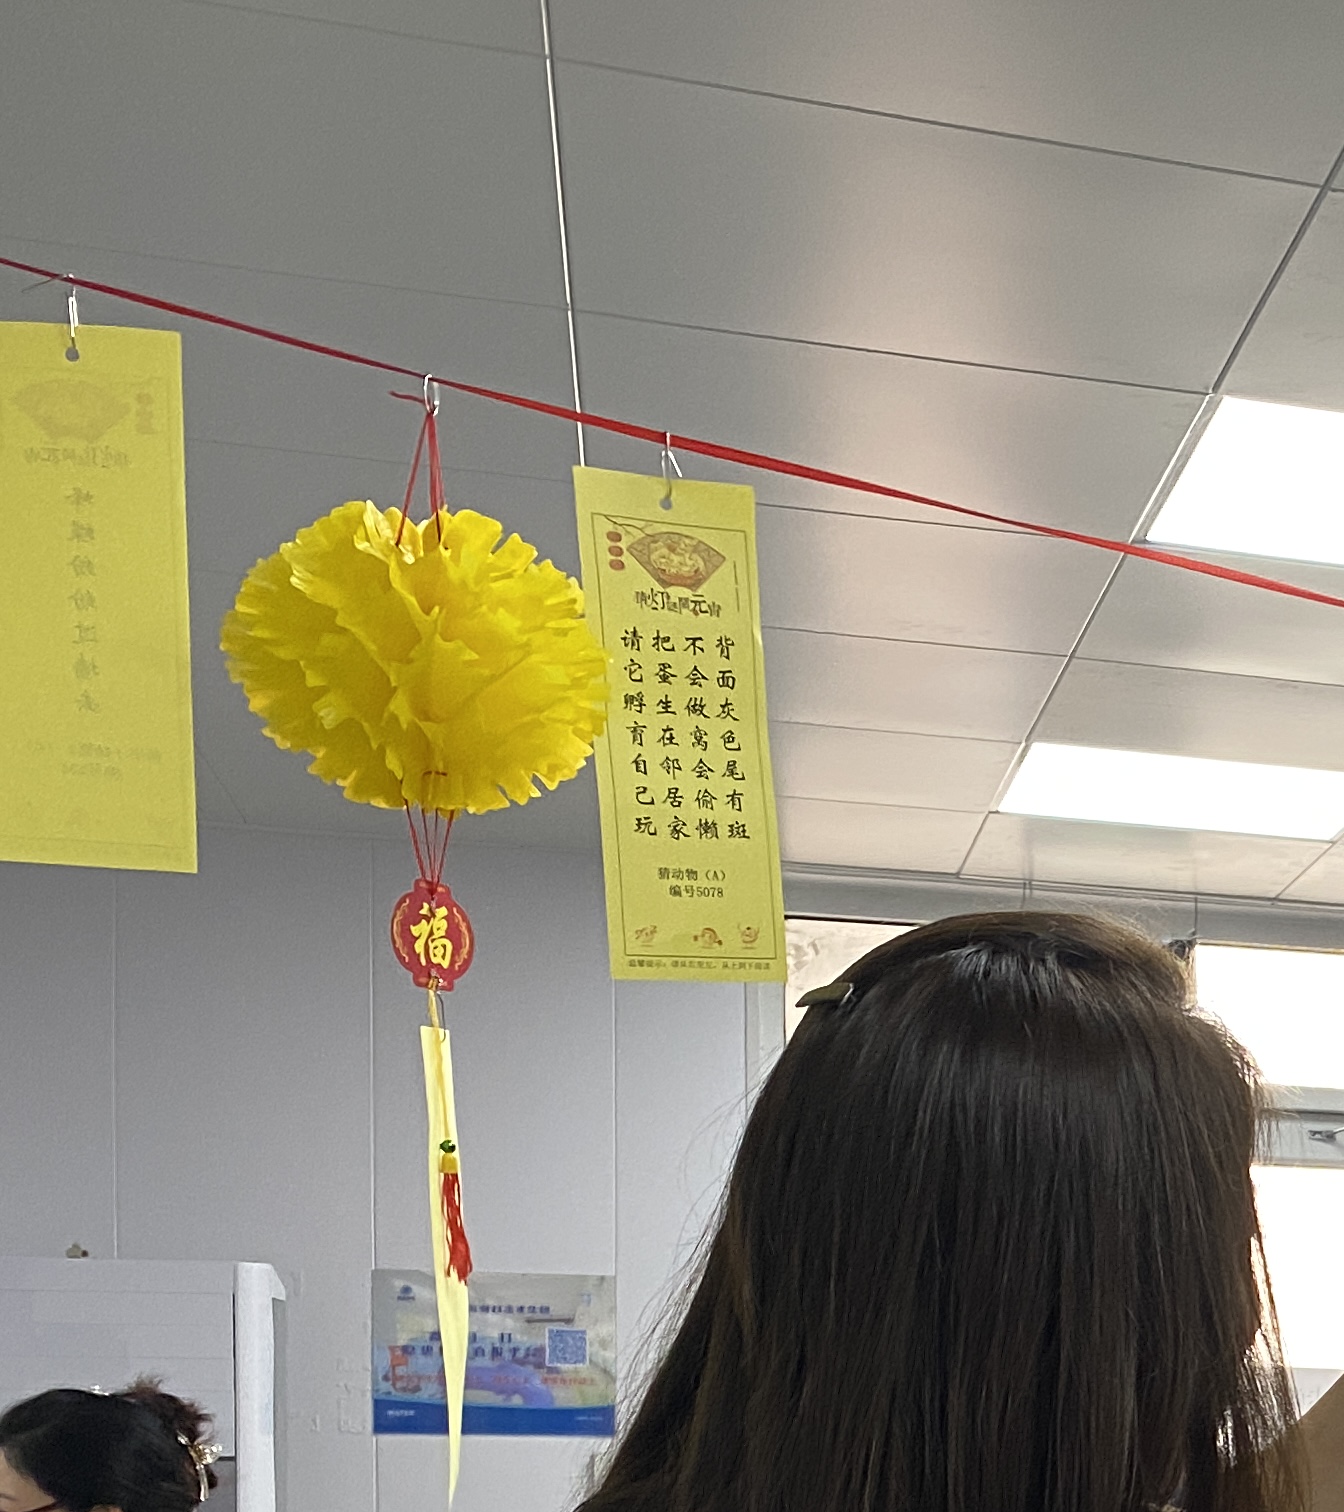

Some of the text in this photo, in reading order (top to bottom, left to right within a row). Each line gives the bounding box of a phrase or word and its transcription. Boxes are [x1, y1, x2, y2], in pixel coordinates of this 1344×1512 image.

[620, 626, 657, 836] 请它孵育自己玩
[652, 630, 691, 840] 把蛋生在邻居家
[683, 636, 719, 840] 不会做窝会偷懒
[715, 635, 750, 840] 背面灰色尾有斑
[410, 902, 453, 969] 福
[669, 885, 723, 898] 编号5078
